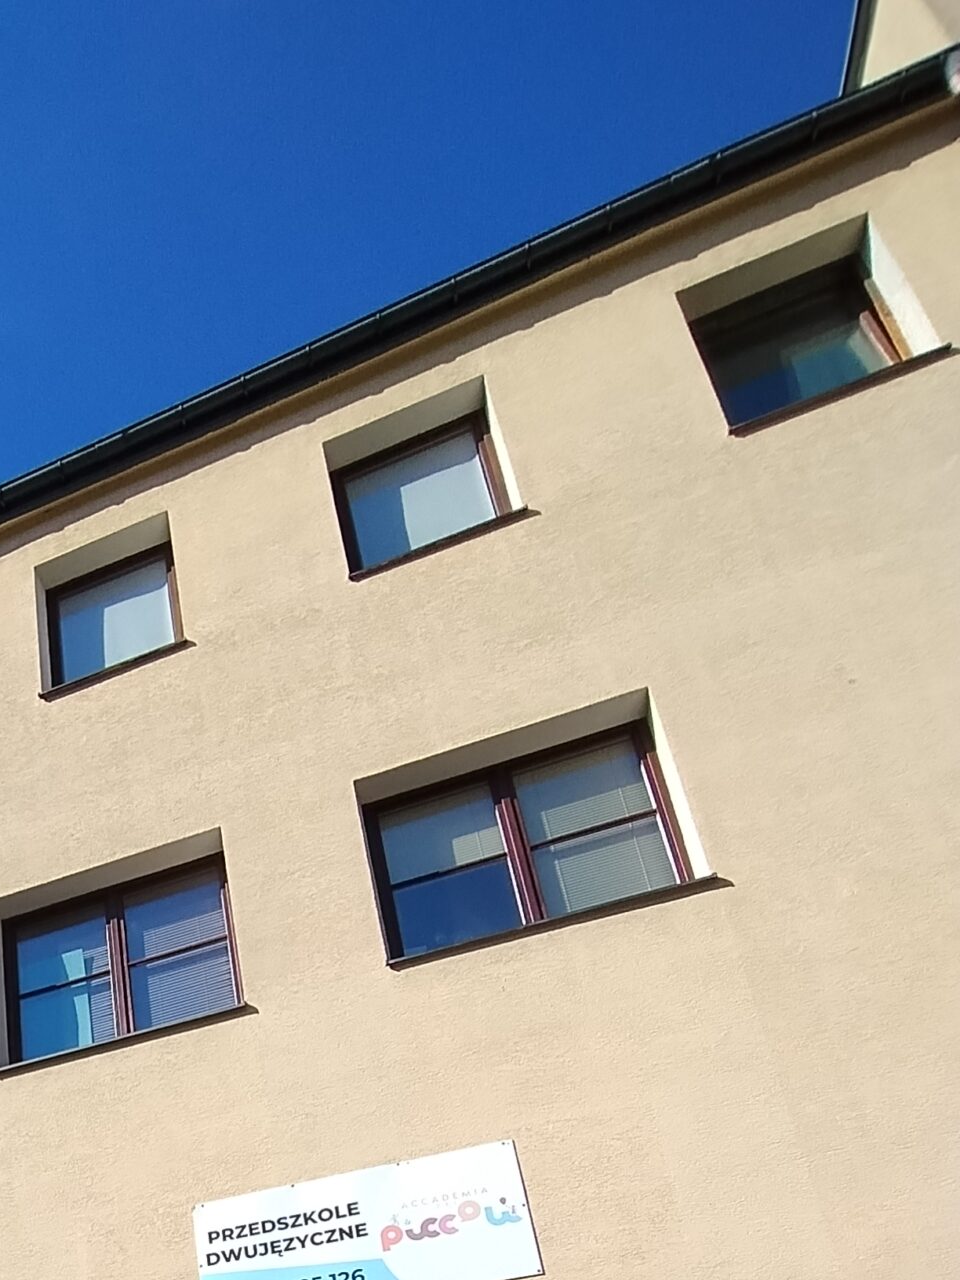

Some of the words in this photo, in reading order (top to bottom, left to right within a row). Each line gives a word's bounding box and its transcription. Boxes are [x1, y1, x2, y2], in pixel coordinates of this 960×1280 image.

[401, 1187, 488, 1209] ACCADEMIA
[207, 1201, 361, 1244] PRZEDSZKOLE
[205, 1222, 369, 1267] DWUJĘZYCZNE
